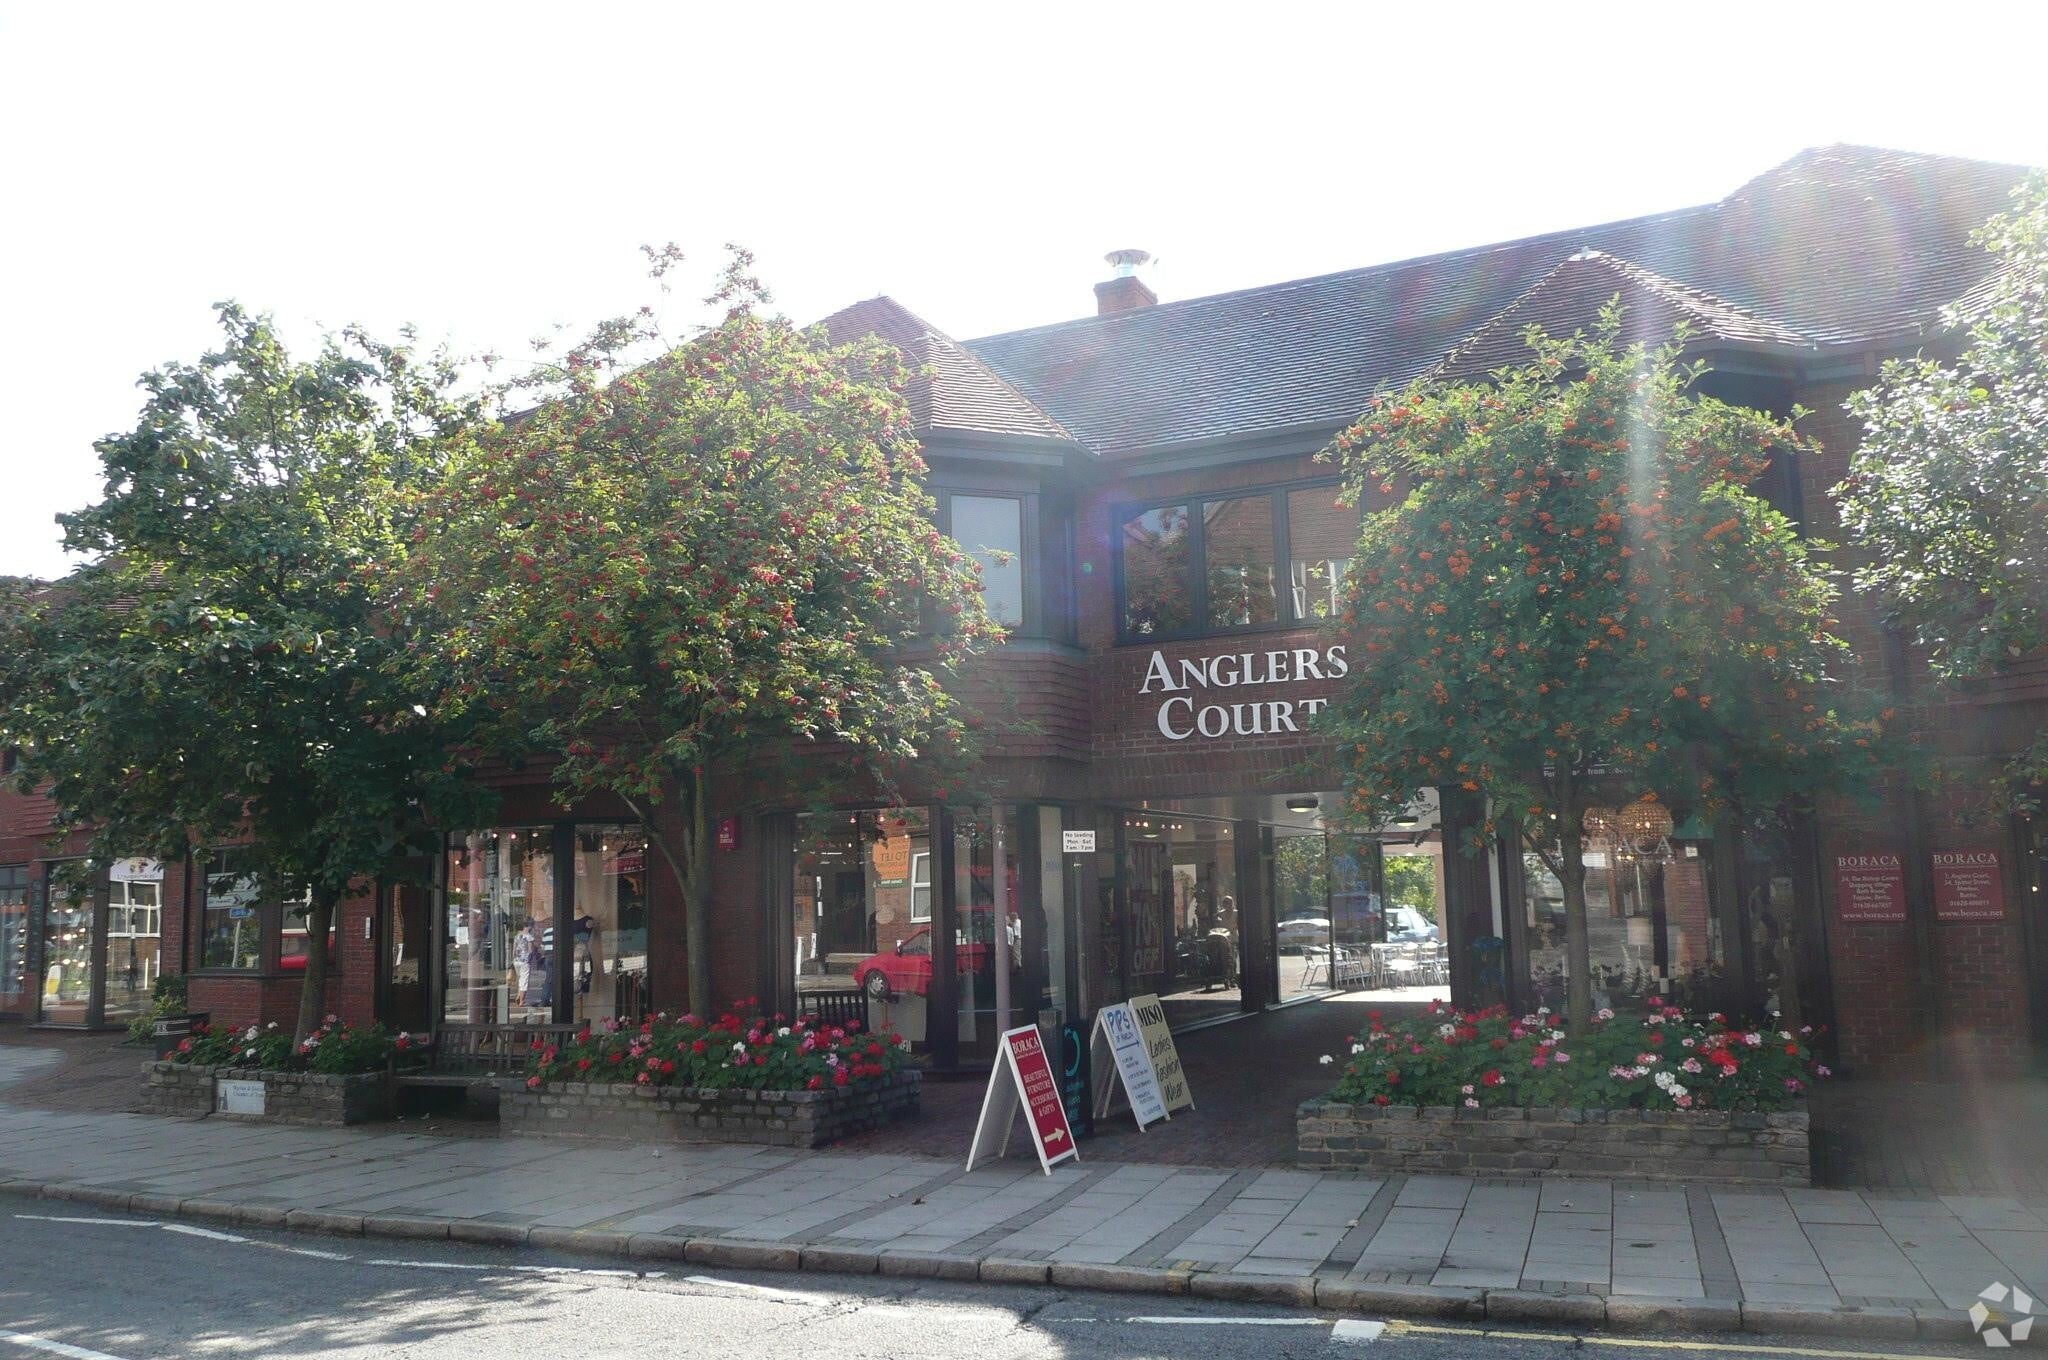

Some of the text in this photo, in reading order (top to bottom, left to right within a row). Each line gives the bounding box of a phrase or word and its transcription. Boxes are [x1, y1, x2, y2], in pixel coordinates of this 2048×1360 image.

[1138, 646, 1348, 694] ANGLERS
[1837, 856, 1900, 867] BORACA
[1933, 853, 1998, 864] BORACA
[1938, 909, 2003, 917] www.boraca.net
[1136, 1005, 1163, 1028] MISO
[1012, 1036, 1040, 1054] BORACA
[1149, 1034, 1172, 1058] Ladies
[1164, 1081, 1183, 1102] Wear
